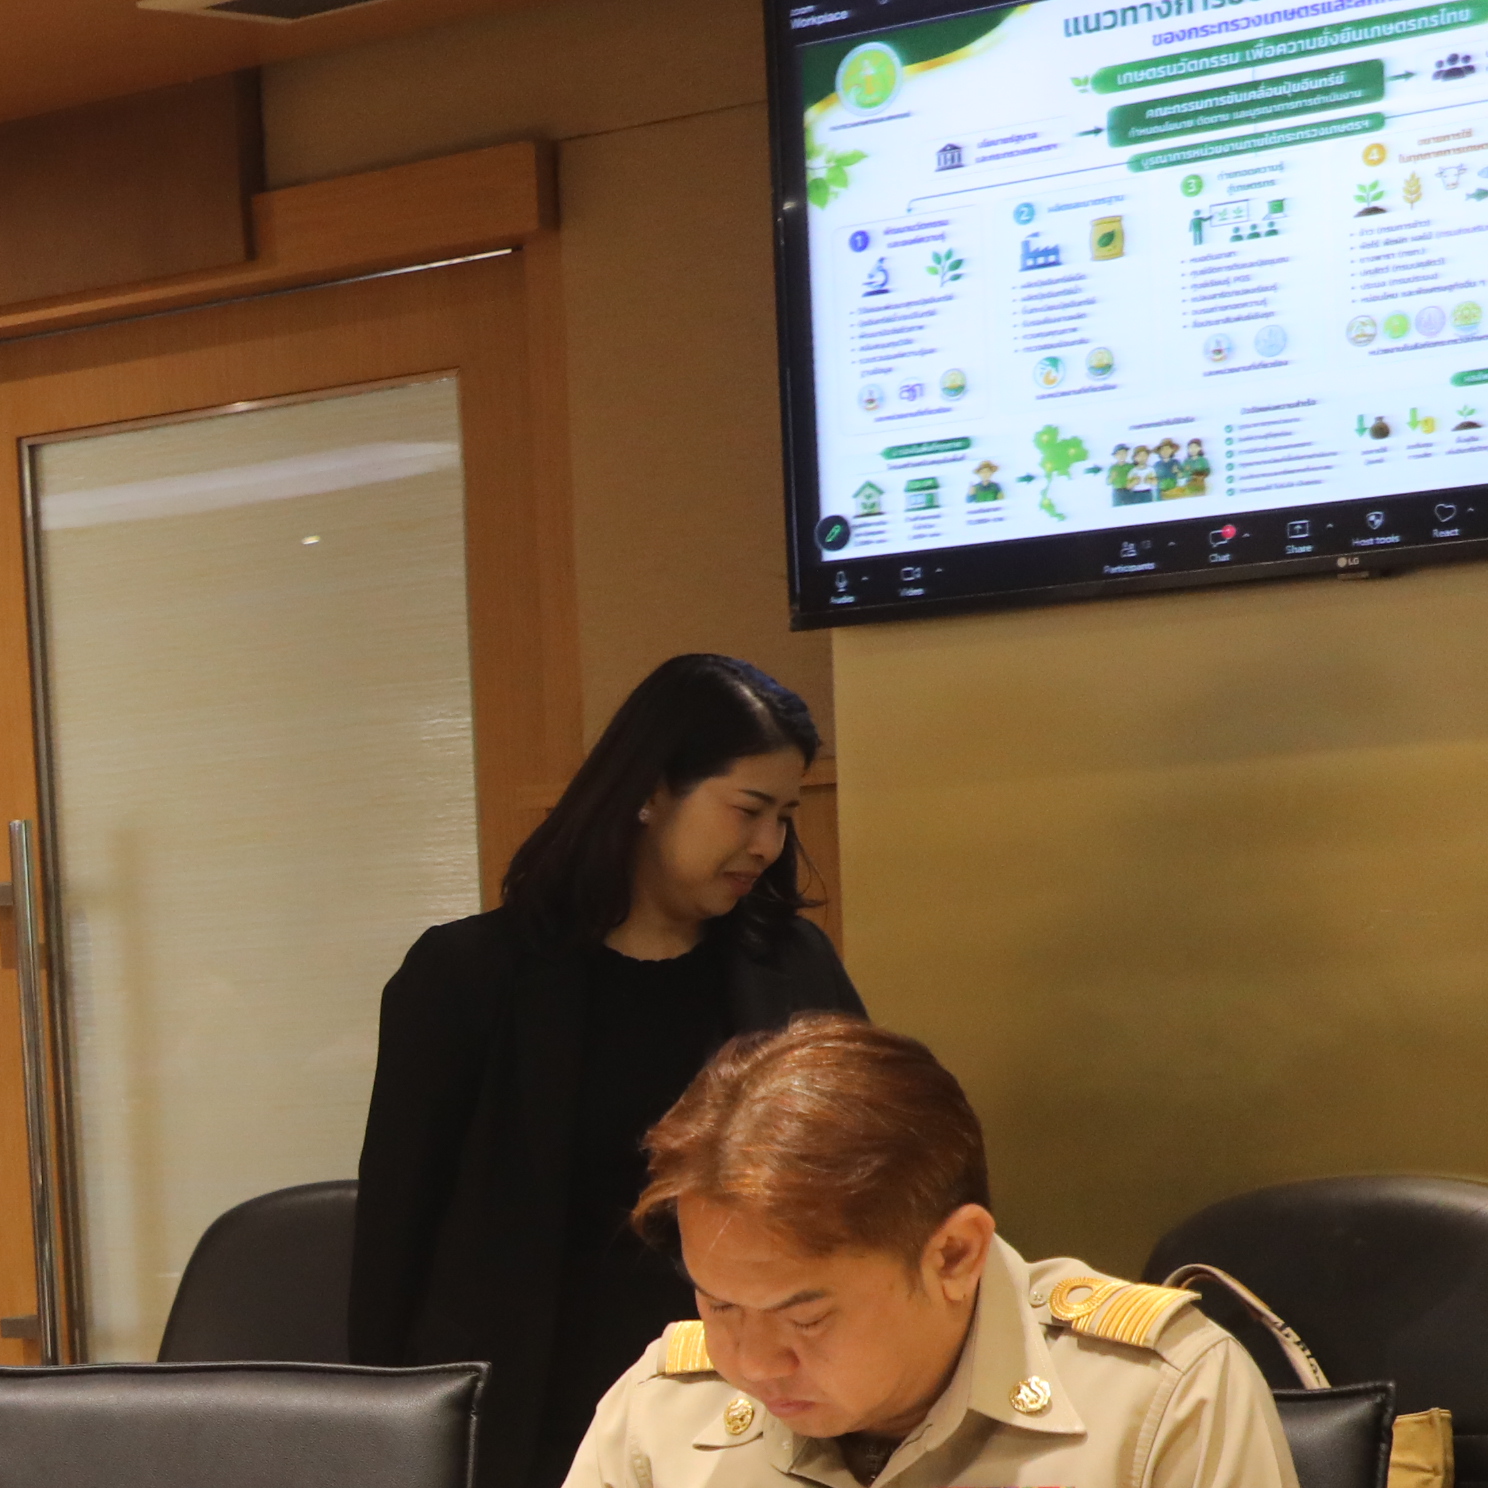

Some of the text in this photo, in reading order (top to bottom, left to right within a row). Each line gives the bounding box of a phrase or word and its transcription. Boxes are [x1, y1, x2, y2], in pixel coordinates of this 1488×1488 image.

[790, 10, 849, 29] Workplace
[1117, 52, 1239, 86] เกษตรนวัตกรรม
[1432, 527, 1460, 538] React
[1352, 534, 1400, 547] Host tools
[1285, 544, 1313, 554] Share
[1209, 553, 1231, 563] Chat
[1103, 562, 1155, 574] Participants
